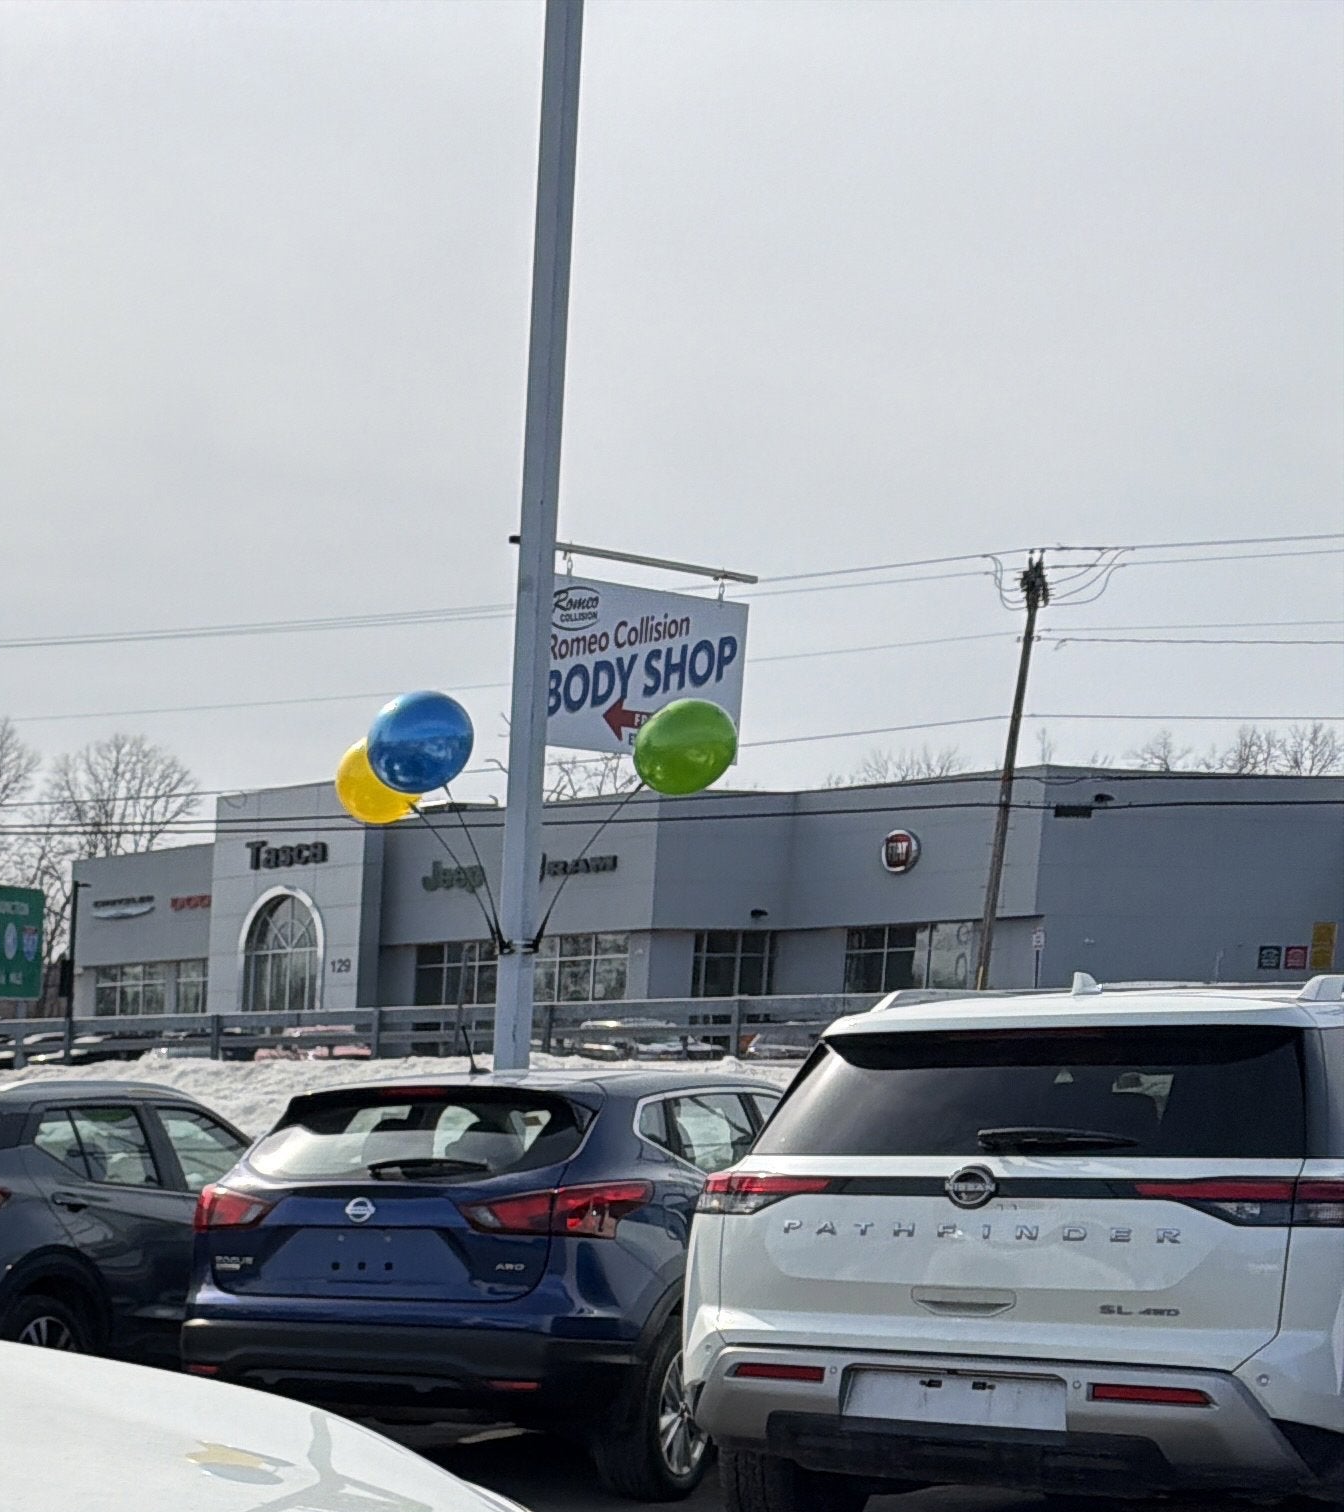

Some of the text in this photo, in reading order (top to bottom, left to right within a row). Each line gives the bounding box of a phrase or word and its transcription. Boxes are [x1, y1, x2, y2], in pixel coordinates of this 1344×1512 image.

[559, 611, 598, 622] COLLISION
[550, 612, 691, 660] Romeo Collision
[547, 635, 738, 717] BODY SHOP
[245, 840, 329, 871] Tasca
[547, 855, 618, 877] RAM
[421, 860, 485, 893] Jeep
[330, 959, 351, 973] 129
[783, 1219, 1182, 1245] PATHFINDER
[1099, 1304, 1133, 1316] SL
